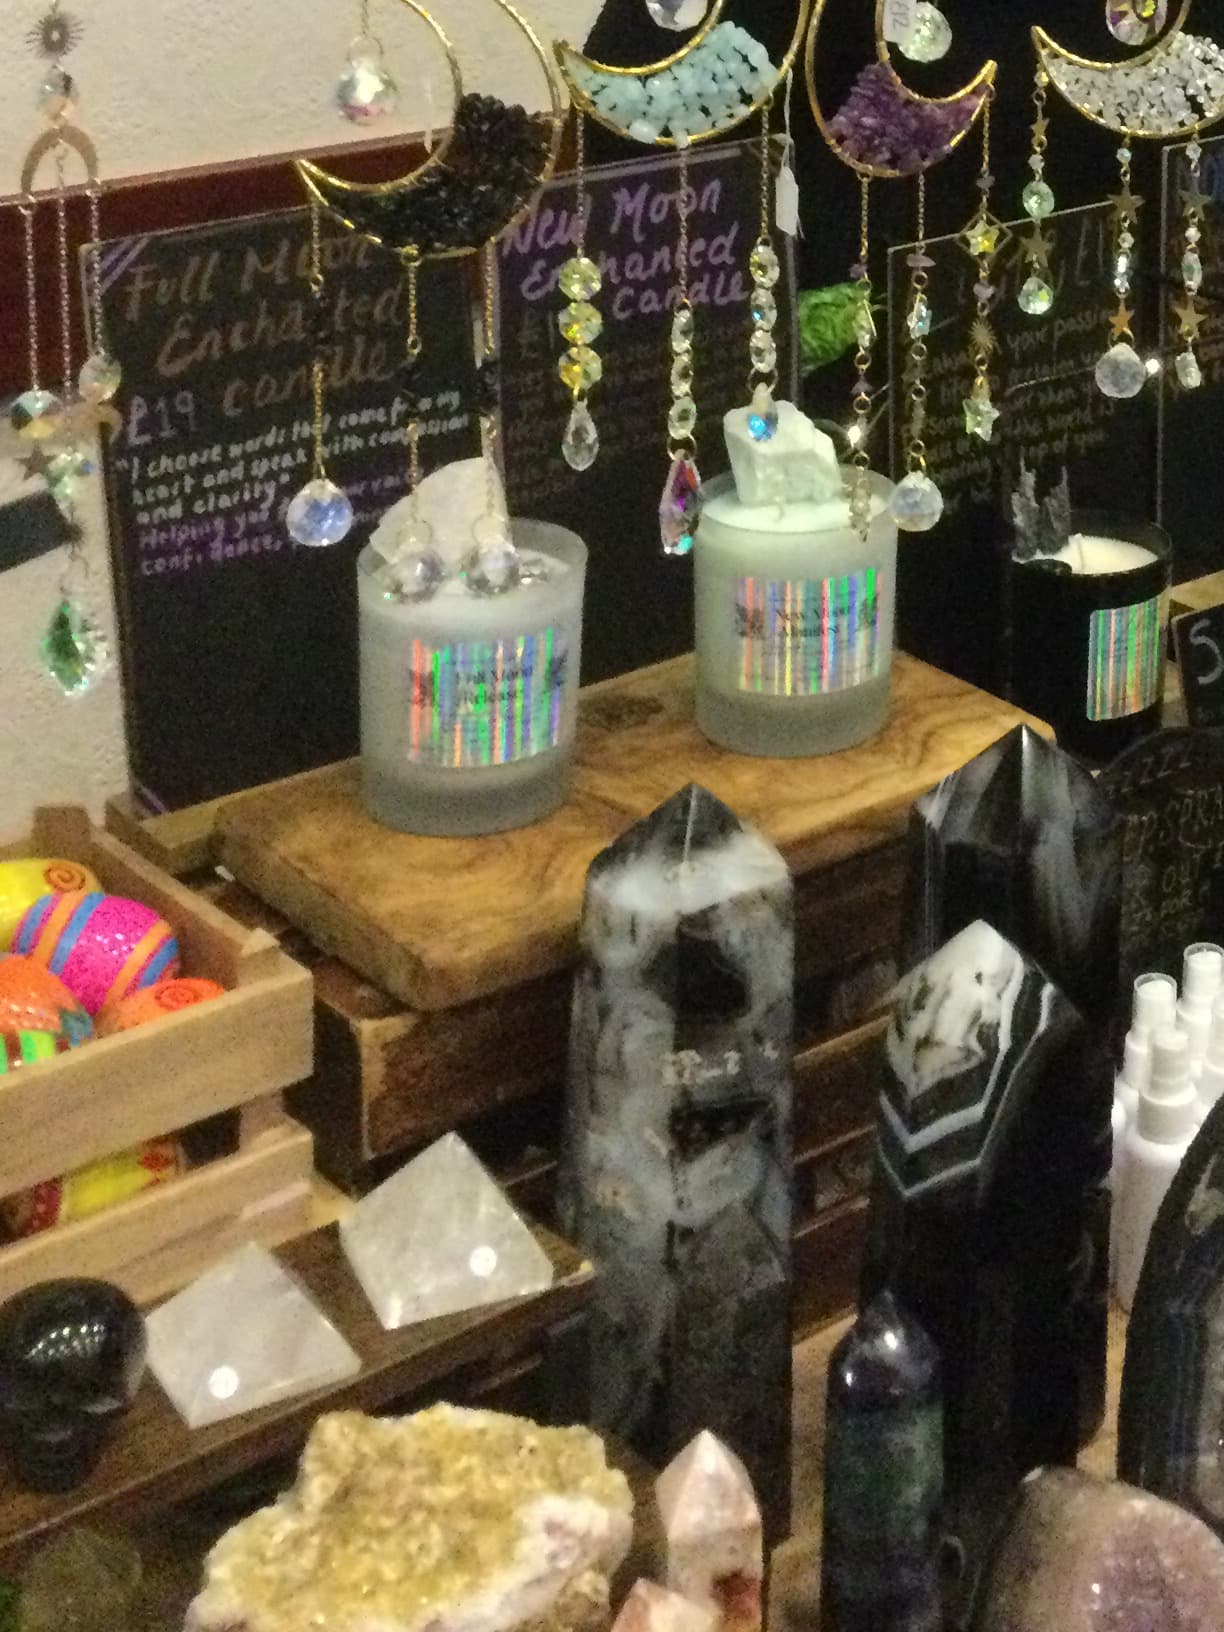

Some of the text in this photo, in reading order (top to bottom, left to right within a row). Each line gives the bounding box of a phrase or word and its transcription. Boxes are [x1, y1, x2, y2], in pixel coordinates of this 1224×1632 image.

[609, 178, 721, 244] Moon
[126, 249, 220, 322] Full
[154, 279, 403, 378] Enchated
